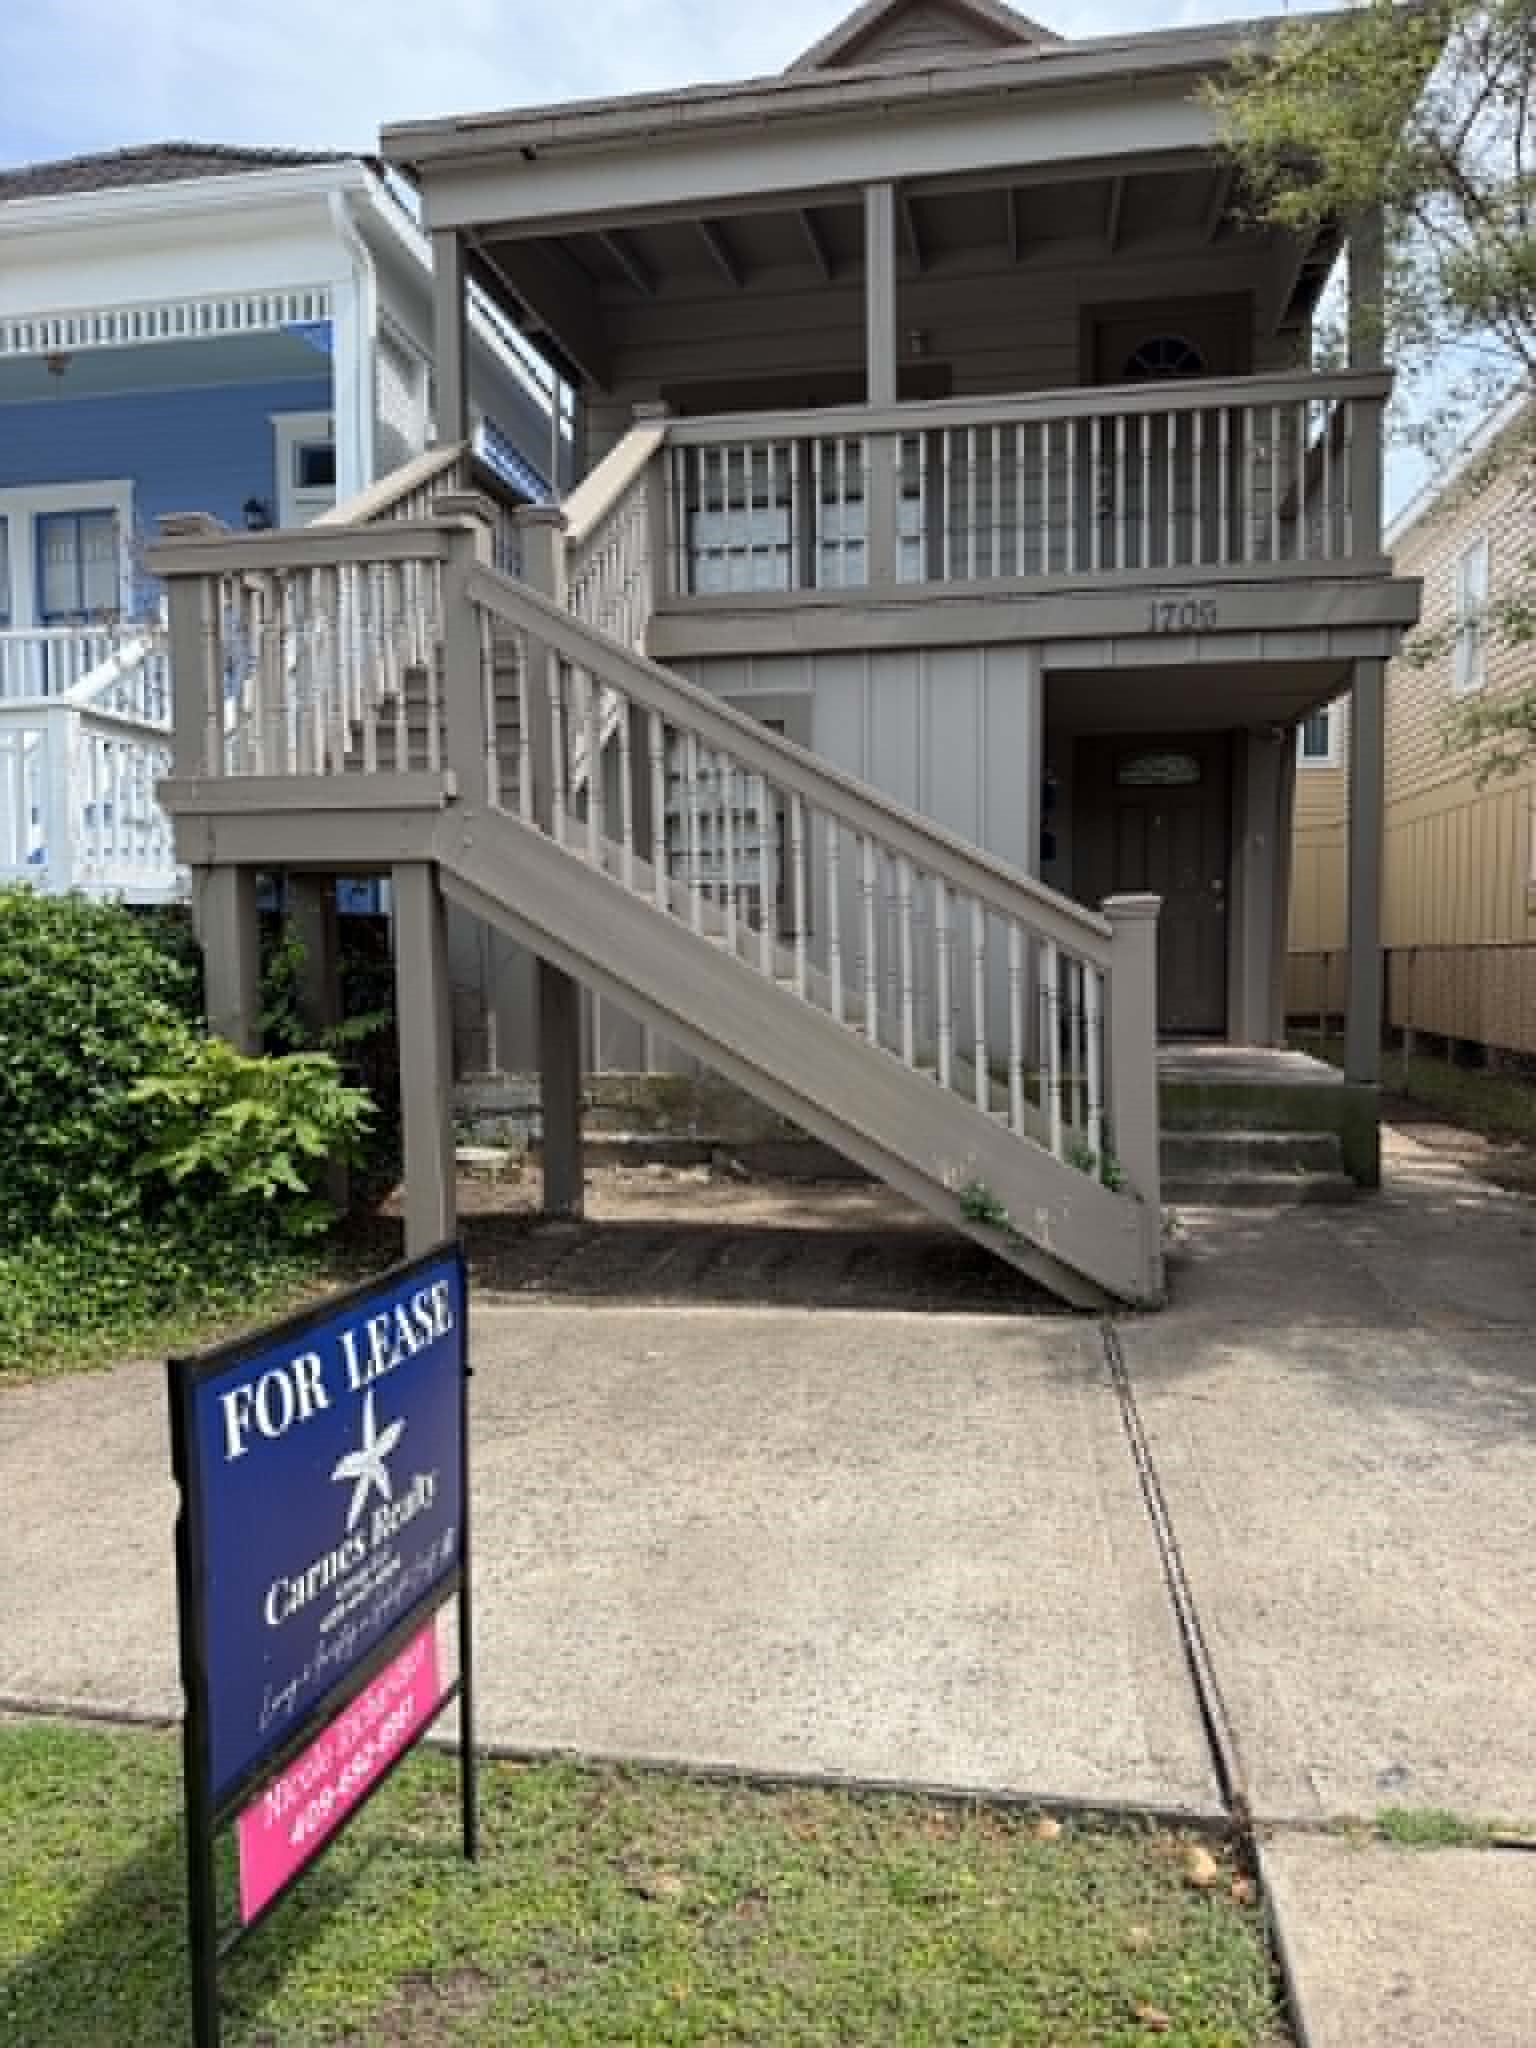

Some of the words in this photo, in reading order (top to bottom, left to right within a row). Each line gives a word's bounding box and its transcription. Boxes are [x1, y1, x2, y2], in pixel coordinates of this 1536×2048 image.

[218, 1352, 331, 1462] FOR
[337, 1279, 454, 1391] LEASE
[264, 1534, 367, 1625] Carnes
